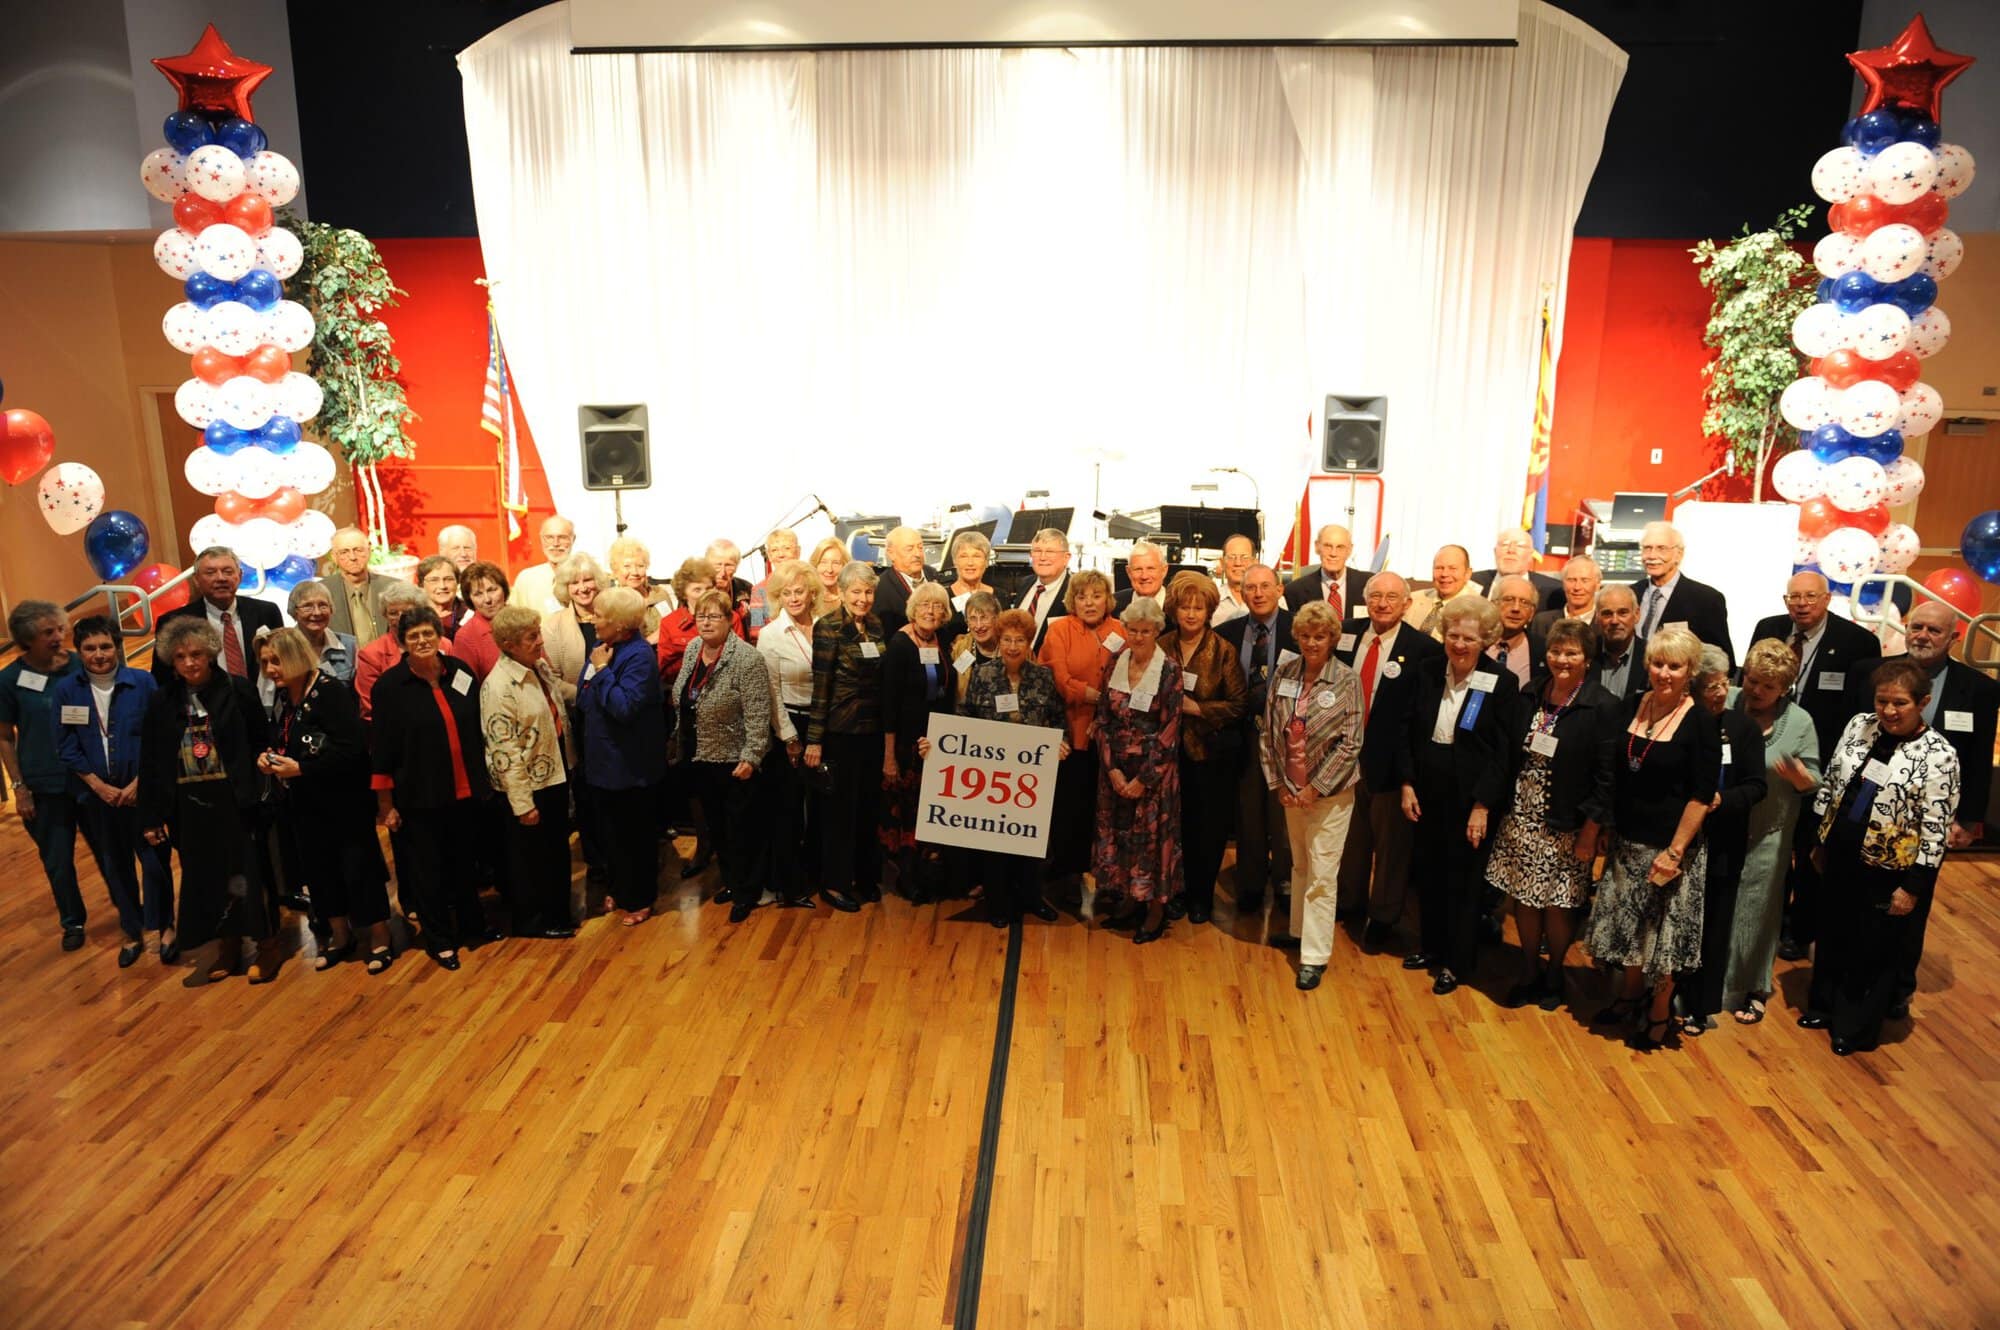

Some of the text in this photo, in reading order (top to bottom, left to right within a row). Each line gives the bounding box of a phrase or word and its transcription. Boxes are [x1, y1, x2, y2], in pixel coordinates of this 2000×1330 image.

[938, 734, 1049, 766] Class of
[938, 765, 1038, 808] 1958
[926, 804, 1037, 838] Reunion
